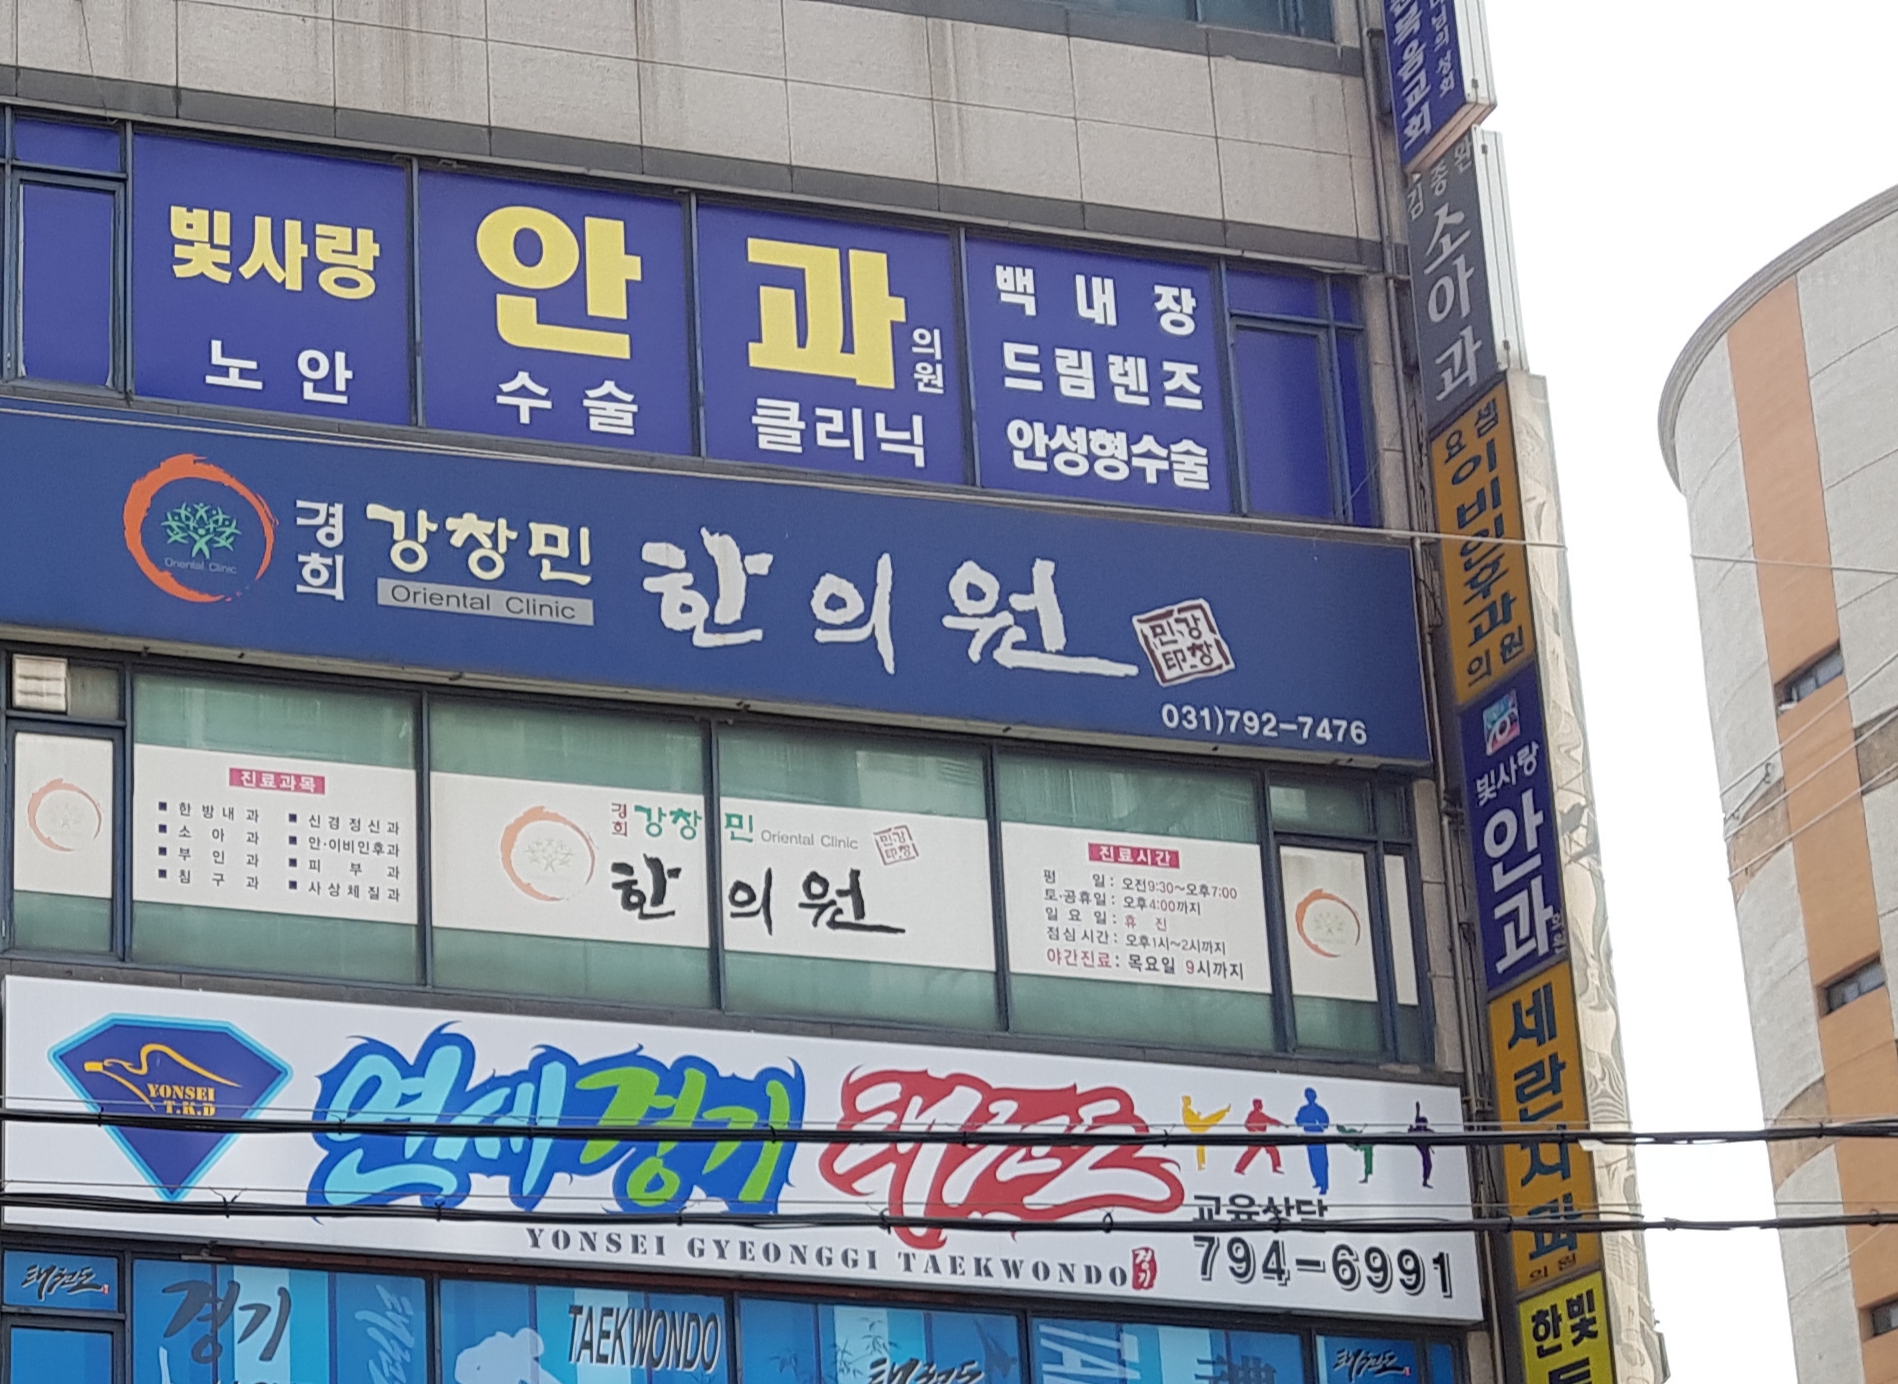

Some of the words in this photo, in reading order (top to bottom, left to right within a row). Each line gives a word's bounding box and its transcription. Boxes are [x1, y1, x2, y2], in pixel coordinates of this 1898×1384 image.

[169, 205, 381, 300] 빛사랑
[910, 327, 945, 395] 의원
[1423, 202, 1483, 402] 소아과
[1002, 341, 1204, 410] 드림렌즈
[751, 397, 925, 467] 클리닉
[1006, 418, 1210, 490] 안성형수술
[296, 500, 345, 601] 경희
[366, 503, 593, 586] 강창민
[390, 583, 492, 613] Oriental
[504, 596, 577, 621] Clinic
[1160, 703, 1368, 746] 031)792-7476
[240, 769, 318, 794] 진료과목
[1475, 740, 1539, 808] 빛사랑
[760, 828, 815, 847] Oriental
[819, 834, 860, 850] Clinic
[1099, 844, 1172, 867] 진료시간
[1128, 953, 1176, 975] 목요일
[1185, 958, 1245, 982] 9시까지
[147, 1082, 217, 1102] YONSEI
[163, 1099, 217, 1117] T.K.D
[526, 1227, 668, 1261] YONSEI
[686, 1236, 880, 1271] GYEONGGI
[897, 1250, 1128, 1289] TAEKWONDO
[1192, 1235, 1453, 1298] 794-6991
[162, 1280, 293, 1366] 경기
[567, 1304, 723, 1374] TAEKWONDO
[1531, 1288, 1600, 1359] 한빛
